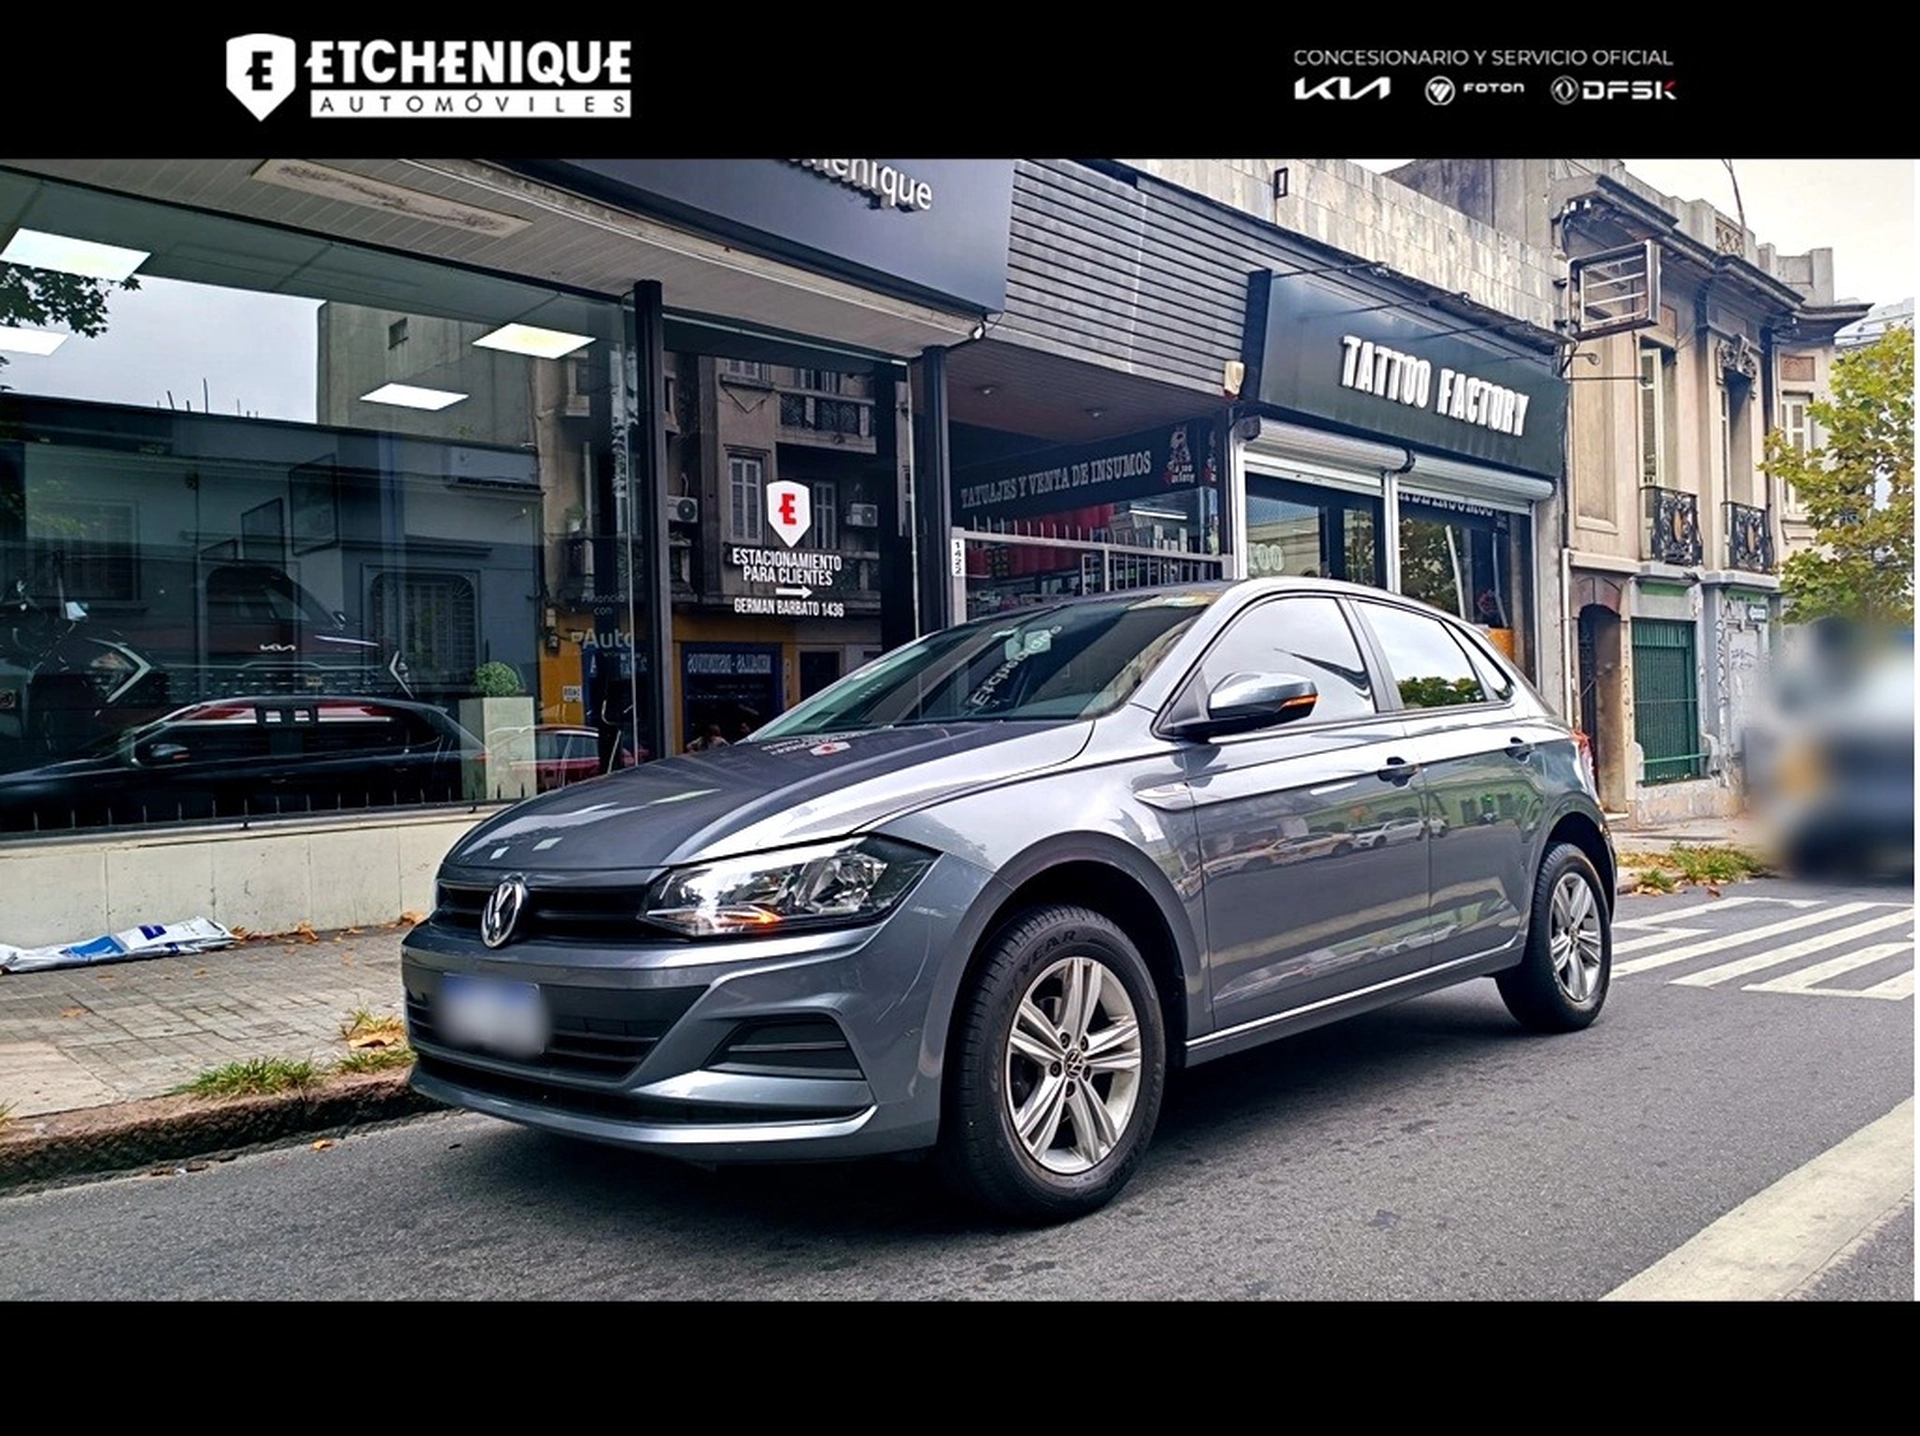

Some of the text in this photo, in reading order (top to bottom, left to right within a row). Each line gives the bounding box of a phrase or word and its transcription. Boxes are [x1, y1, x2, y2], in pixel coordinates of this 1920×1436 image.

[1341, 335, 1531, 437] TATTOO FACTORY
[959, 475, 1018, 509] TATUAJES
[1016, 474, 1028, 498] Y
[1028, 466, 1071, 495] VENTA
[1071, 463, 1089, 488] DE
[1090, 450, 1153, 483] INSUMOS
[732, 547, 842, 571] ESTACIONAMIENTO
[743, 566, 833, 587] PARA CLIENTES
[733, 597, 845, 618] GERMAN BARBATO 1436
